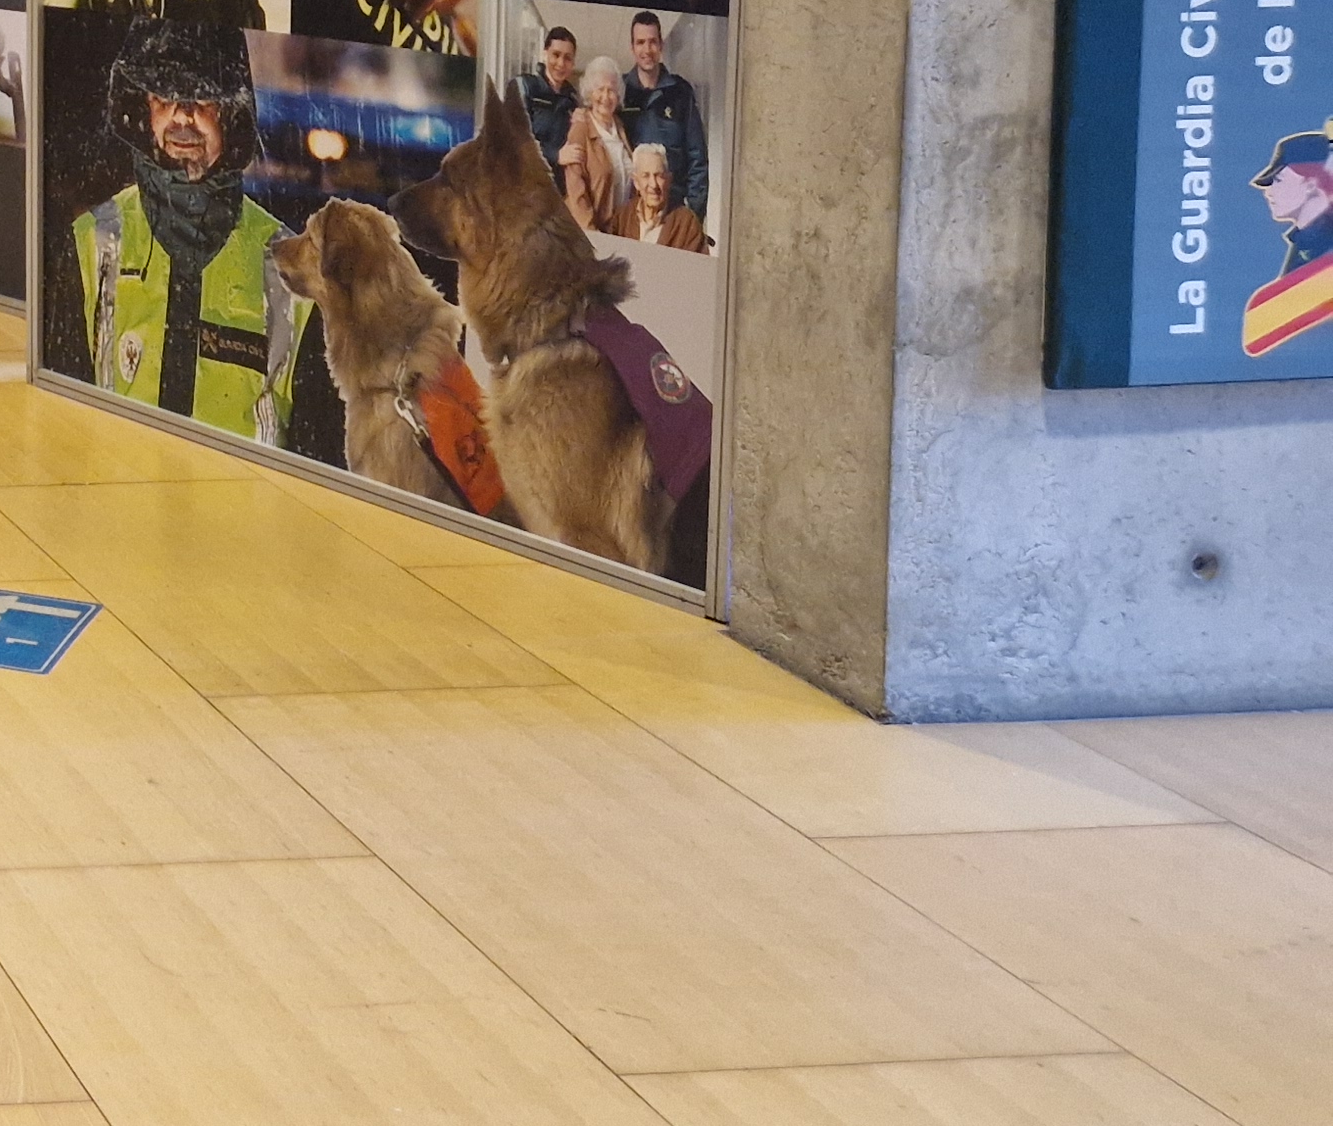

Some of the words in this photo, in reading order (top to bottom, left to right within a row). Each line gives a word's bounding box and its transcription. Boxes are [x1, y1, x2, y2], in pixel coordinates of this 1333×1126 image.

[1255, 23, 1294, 86] de
[1169, 73, 1216, 268] Guardia
[1167, 280, 1207, 335] La
[5, 636, 39, 646] 1
